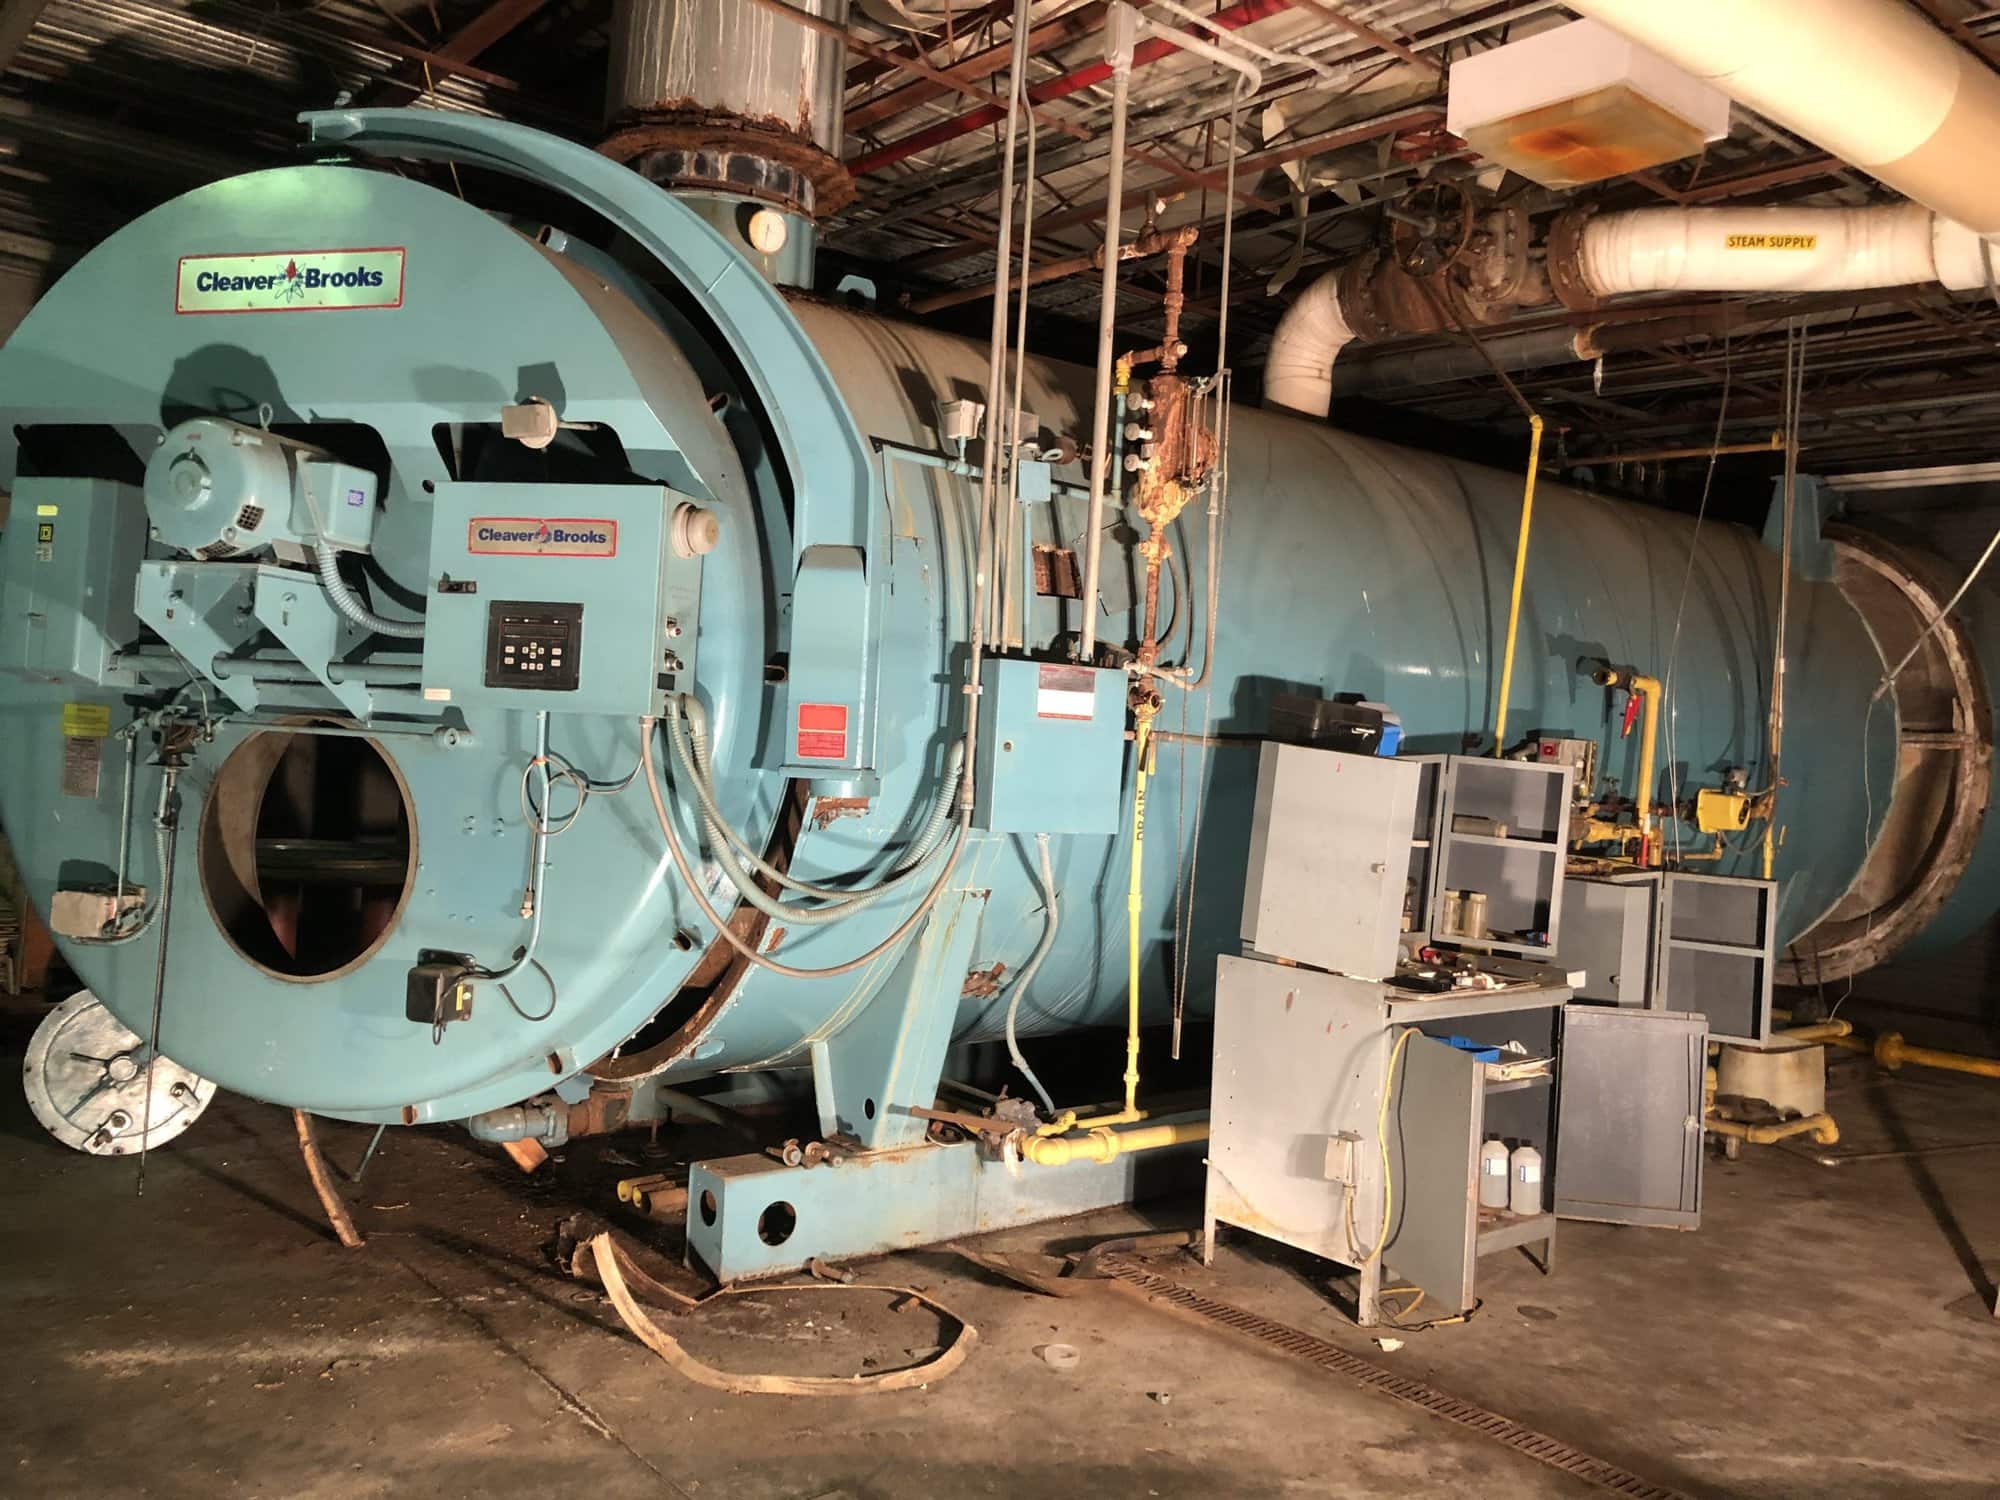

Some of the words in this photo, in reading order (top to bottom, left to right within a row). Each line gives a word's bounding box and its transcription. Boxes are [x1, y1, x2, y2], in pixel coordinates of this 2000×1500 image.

[1728, 236, 1765, 248] STEAM
[1769, 236, 1814, 248] SUPPLY
[196, 271, 277, 292] Cleaver
[304, 266, 383, 289] Brooks
[478, 527, 534, 542] Cleaver
[553, 529, 607, 544] Brooks
[1136, 790, 1146, 841] DRAIN
